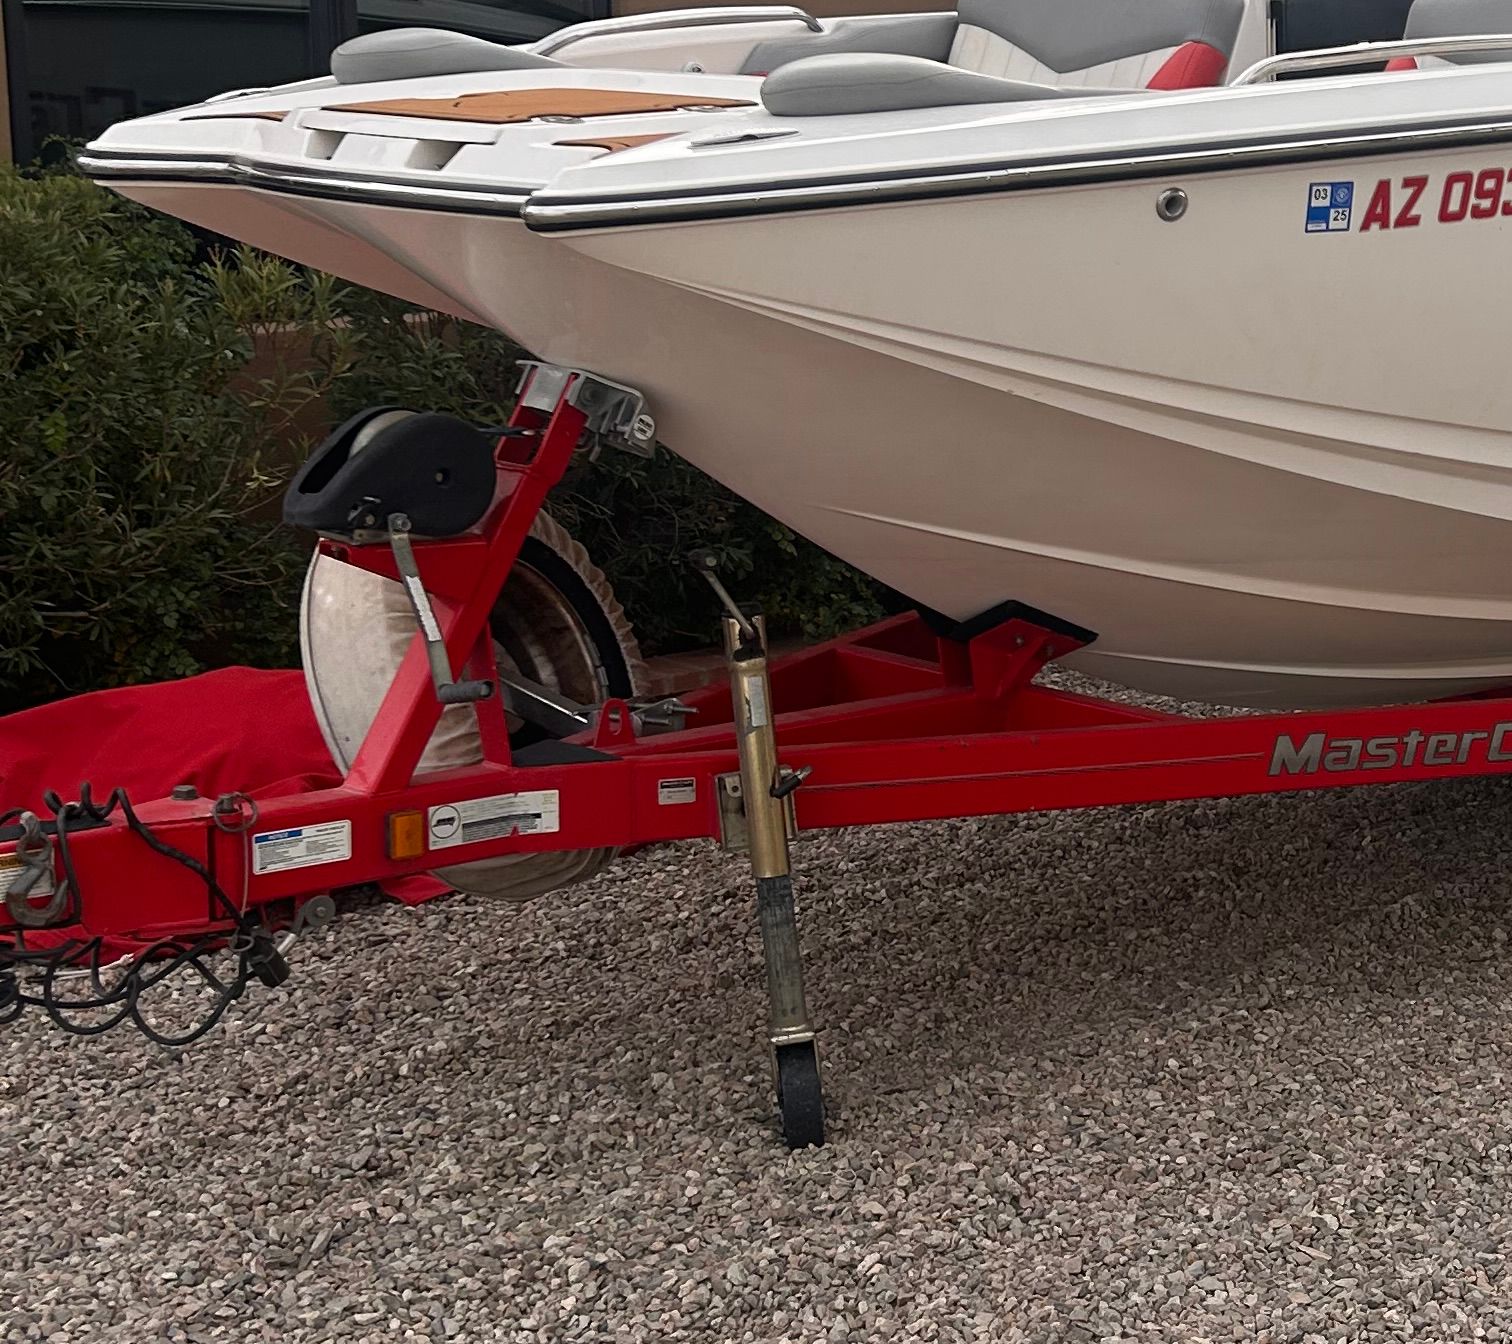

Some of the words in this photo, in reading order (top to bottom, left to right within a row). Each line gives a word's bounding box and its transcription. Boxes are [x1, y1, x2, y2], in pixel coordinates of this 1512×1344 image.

[1314, 188, 1328, 201] 03
[1359, 175, 1429, 232] AZ
[1333, 209, 1347, 222] 25
